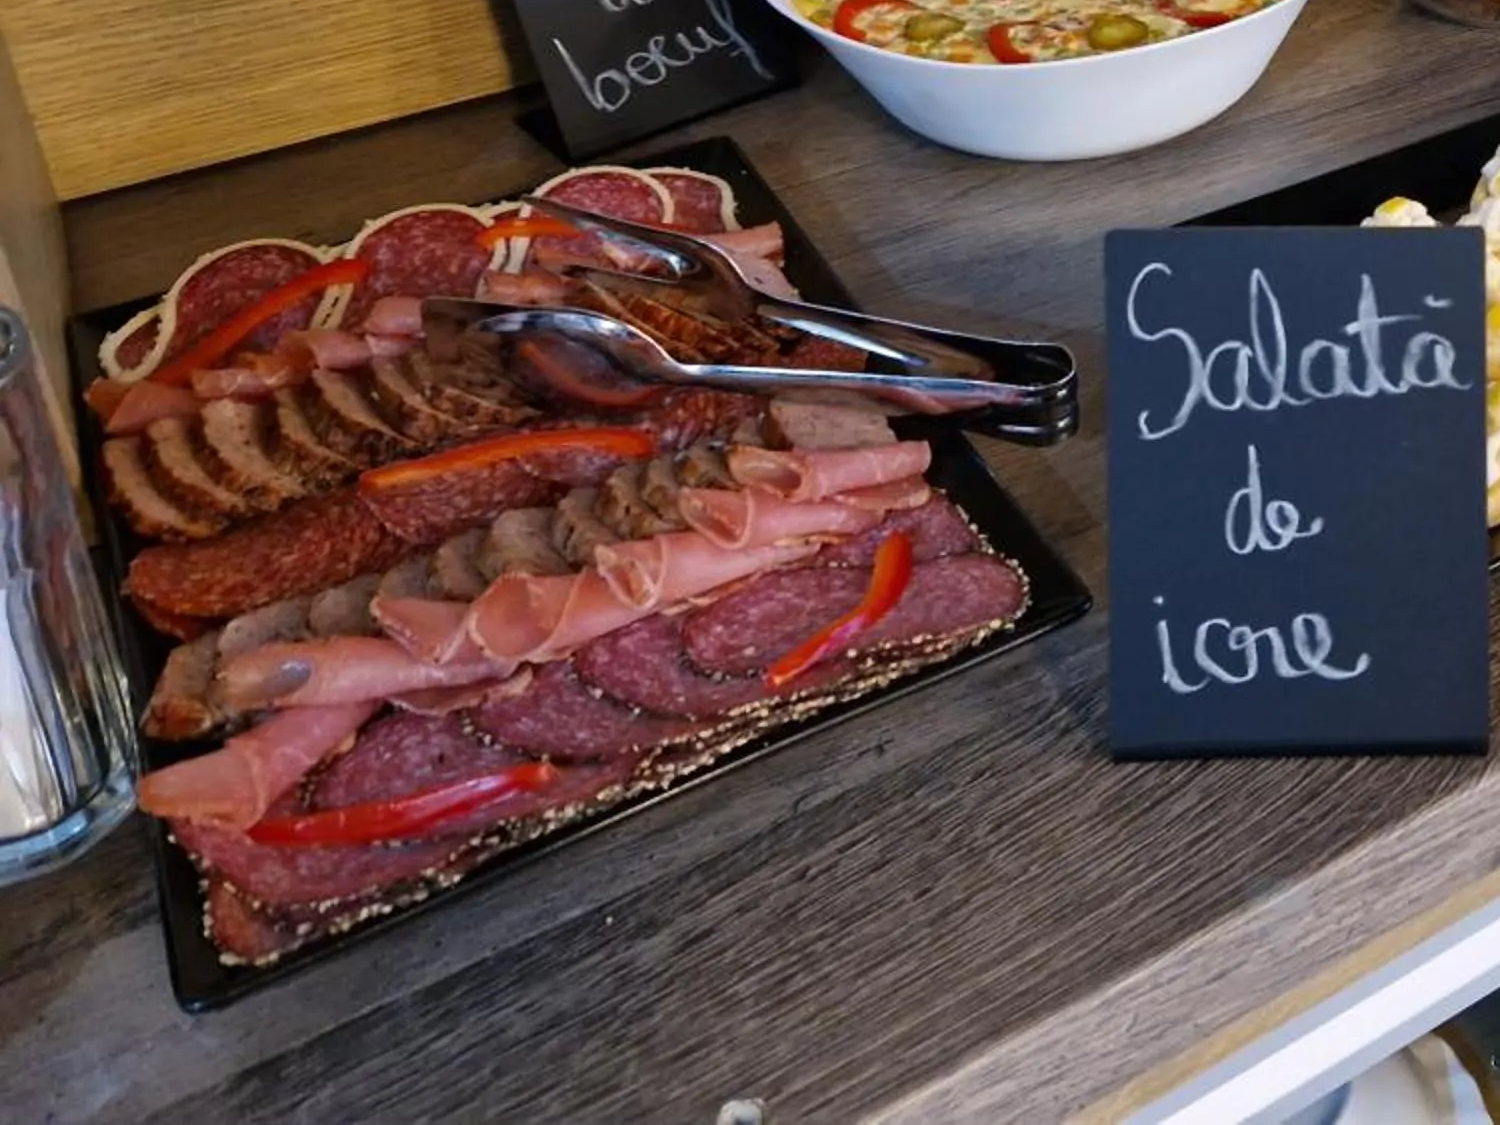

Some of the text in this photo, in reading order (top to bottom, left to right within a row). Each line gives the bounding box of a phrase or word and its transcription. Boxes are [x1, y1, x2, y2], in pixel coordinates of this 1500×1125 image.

[1127, 262, 1473, 440] Salată
[1225, 444, 1324, 554] de
[1152, 595, 1371, 694] icre
